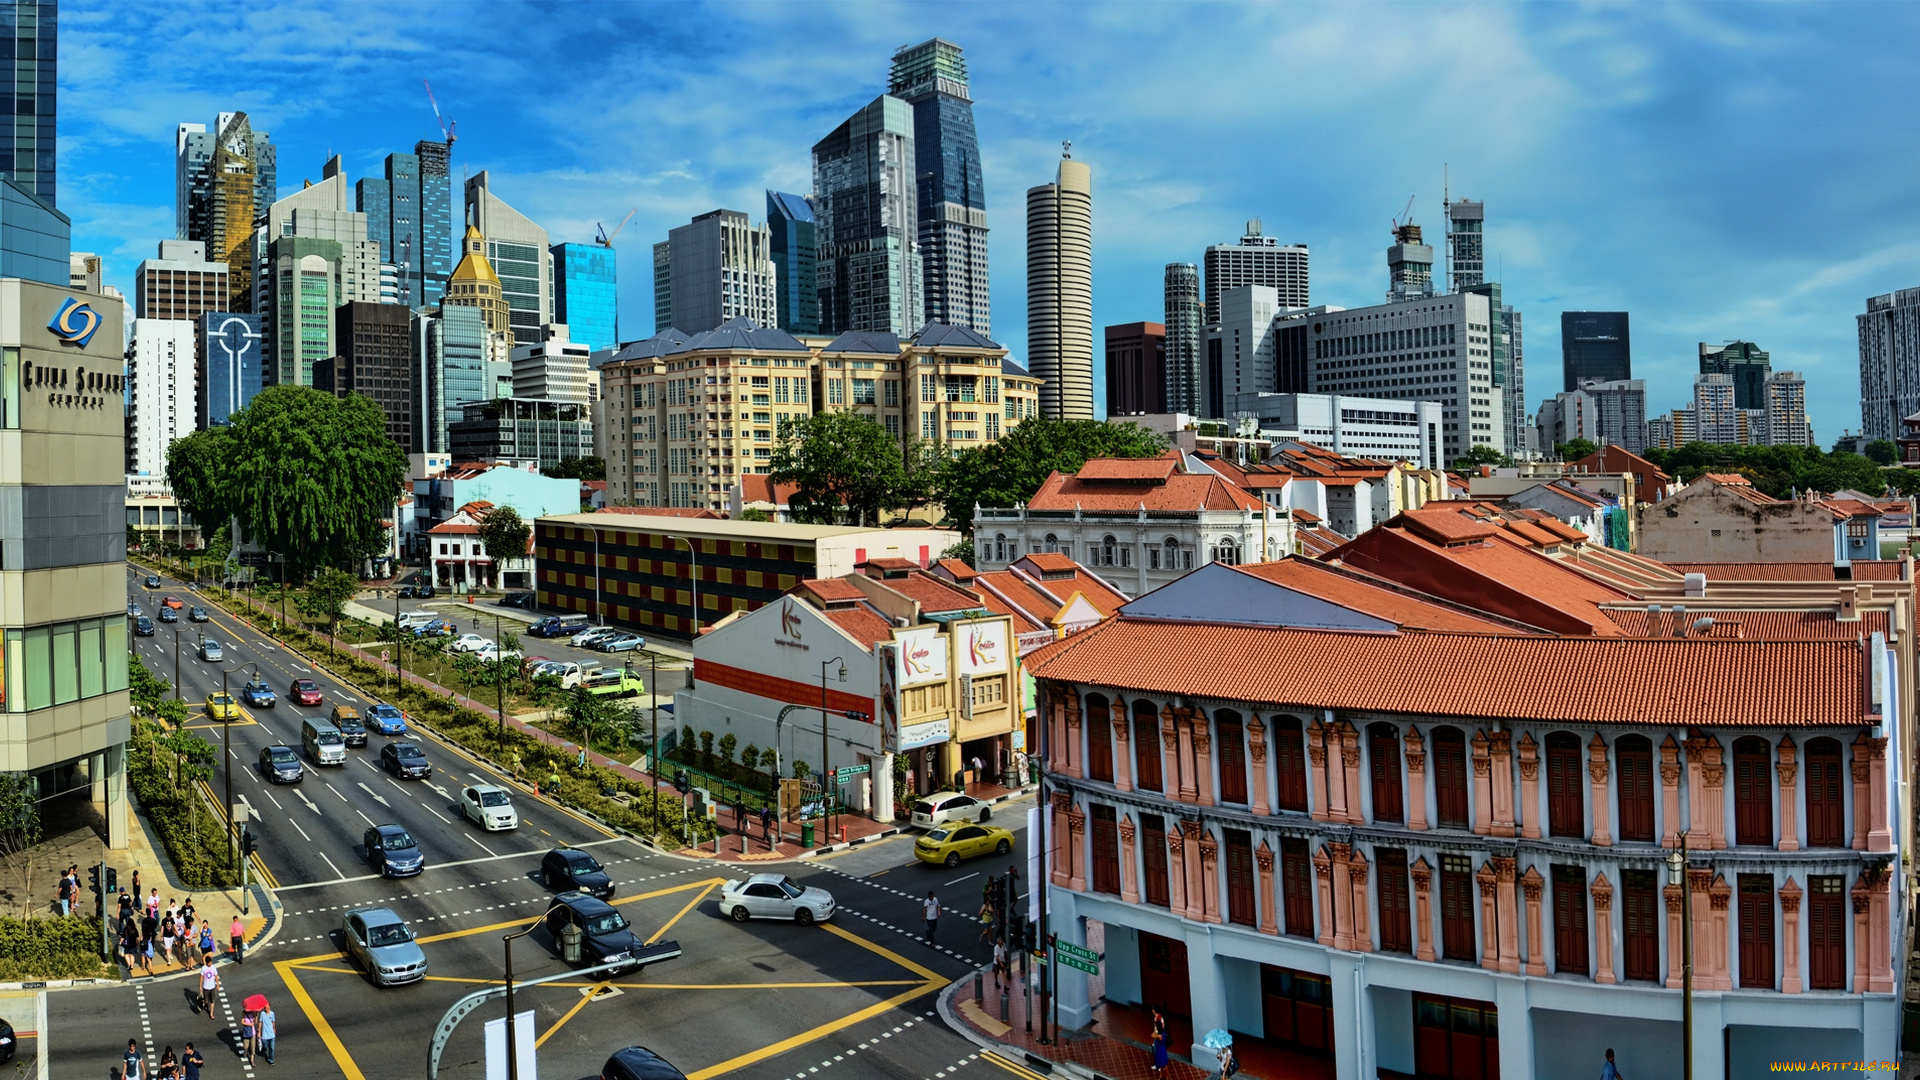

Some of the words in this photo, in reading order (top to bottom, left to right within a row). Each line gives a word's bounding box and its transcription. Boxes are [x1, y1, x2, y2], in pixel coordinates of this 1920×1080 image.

[23, 361, 67, 388] CHINA
[76, 366, 126, 392] SQUARE
[49, 393, 104, 408] CENTRAL
[1058, 941, 1070, 951] Upp
[1071, 945, 1088, 957] Cross
[1089, 951, 1096, 960] St
